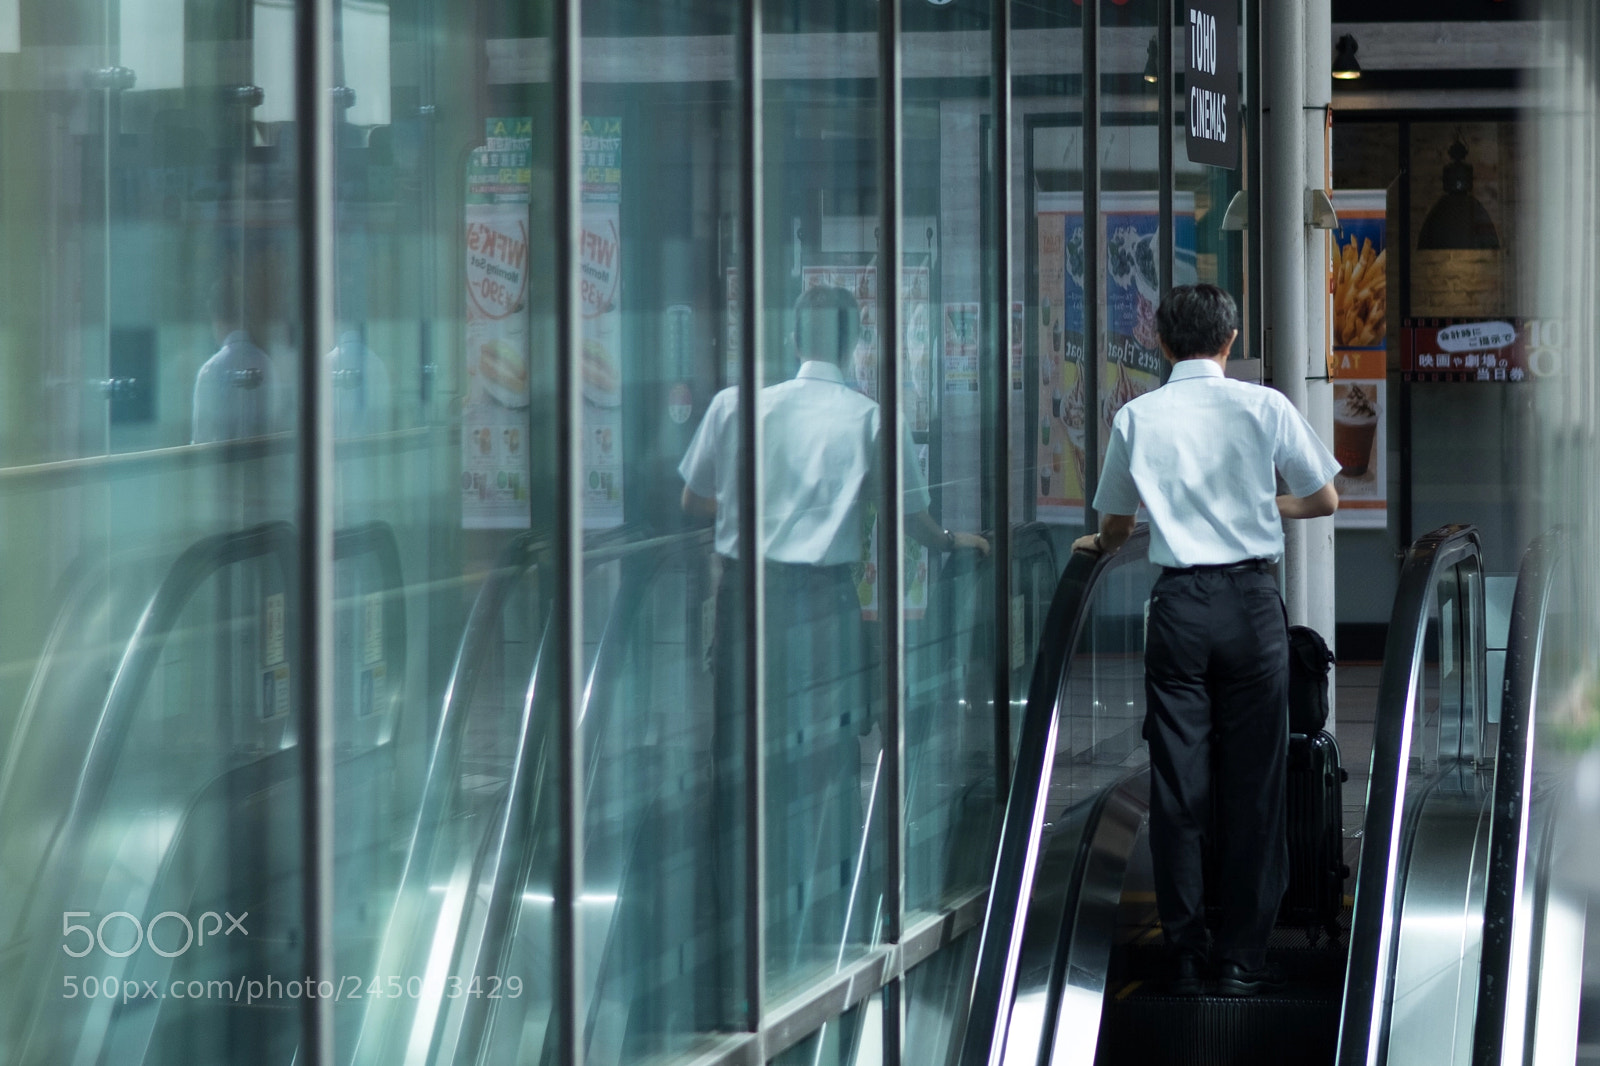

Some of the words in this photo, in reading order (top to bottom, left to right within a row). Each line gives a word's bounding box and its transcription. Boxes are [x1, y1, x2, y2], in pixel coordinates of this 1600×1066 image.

[1190, 9, 1217, 76] TOHO
[1190, 85, 1227, 144] CINEMAS
[1418, 353, 1508, 369] 映画や劇場の
[1477, 367, 1525, 382] 当日券
